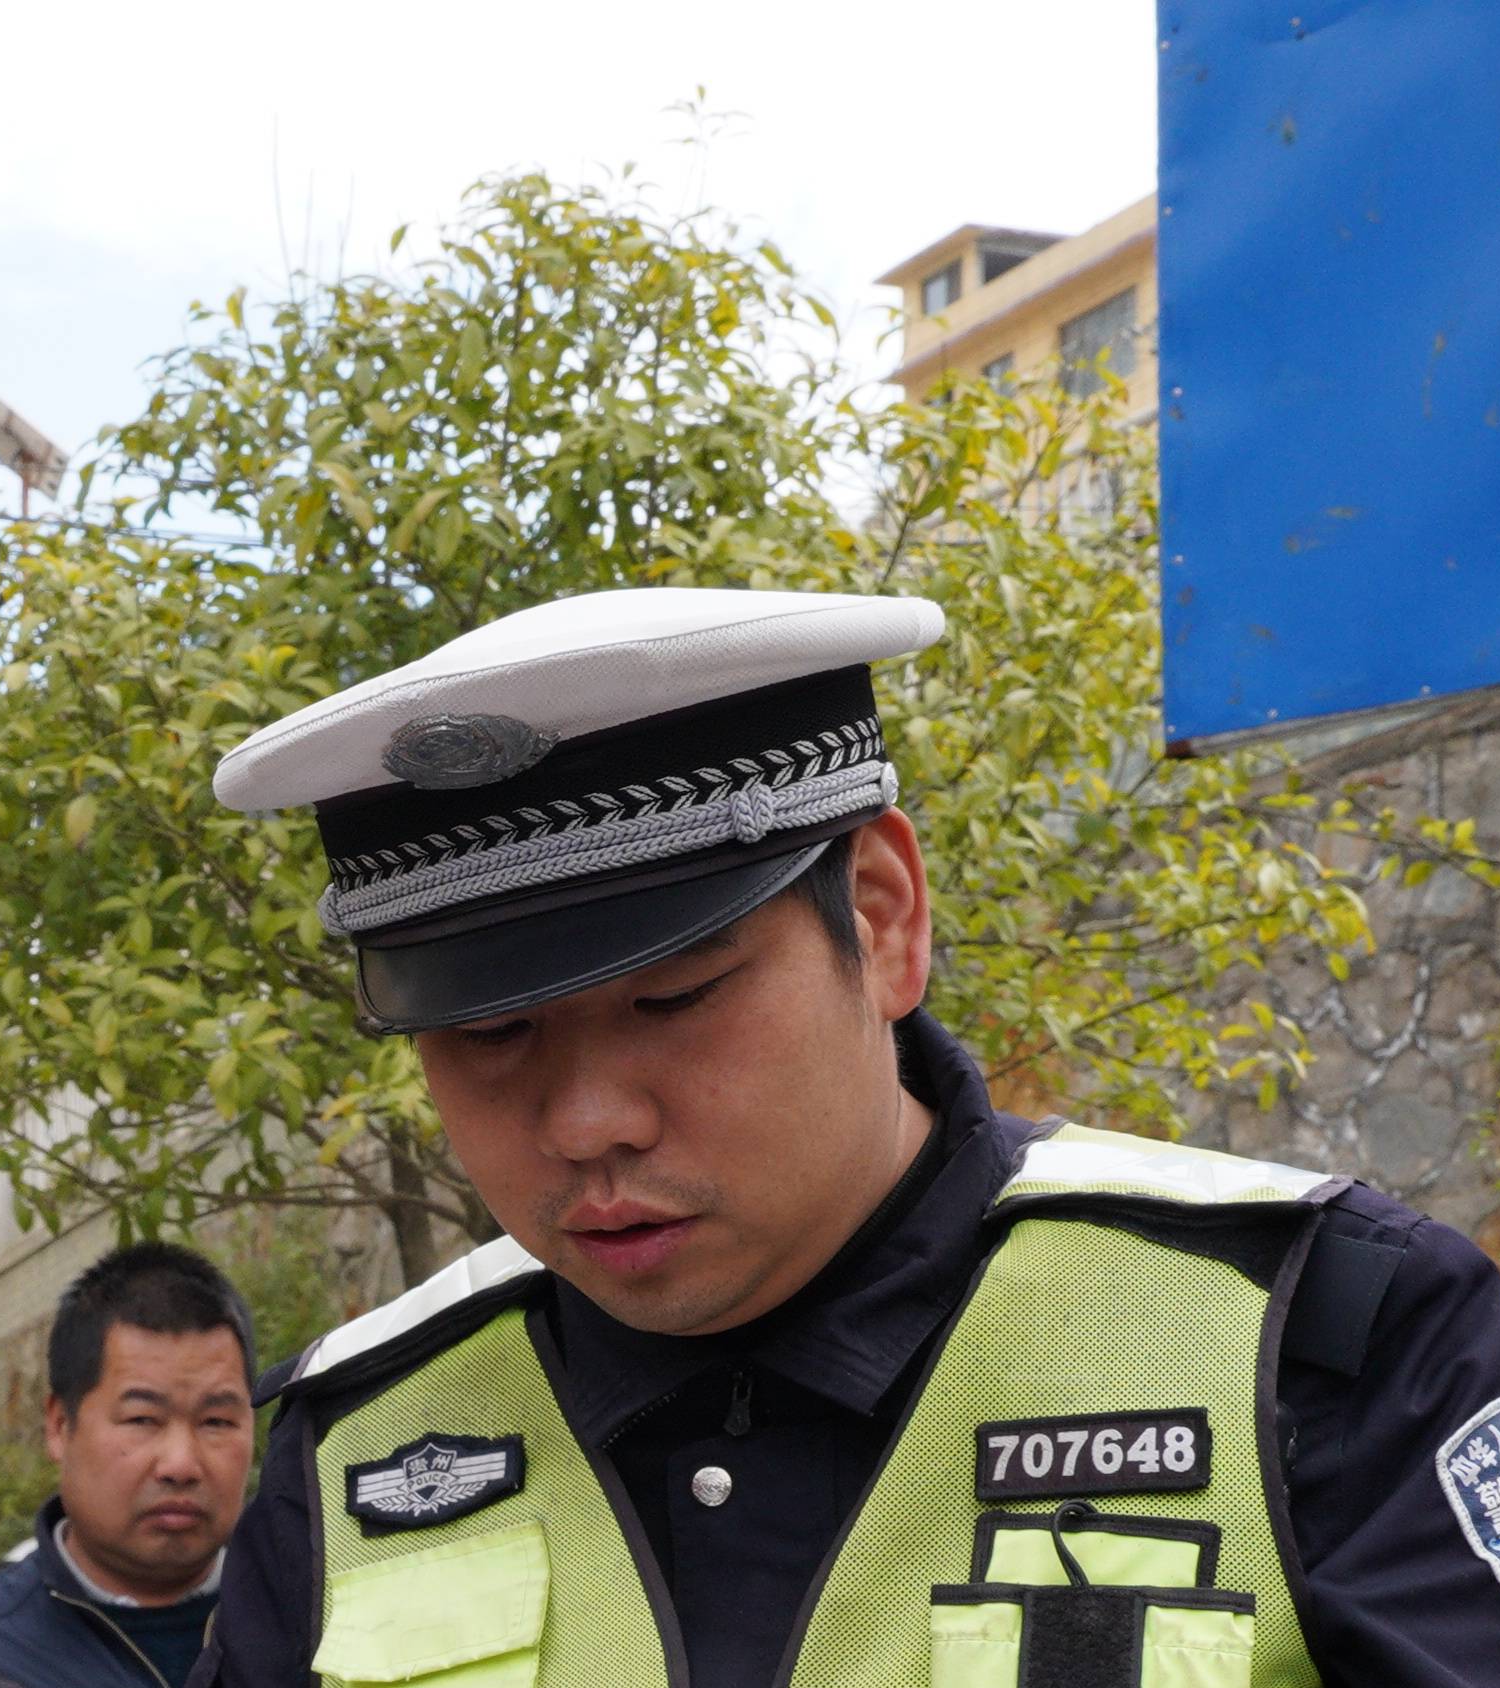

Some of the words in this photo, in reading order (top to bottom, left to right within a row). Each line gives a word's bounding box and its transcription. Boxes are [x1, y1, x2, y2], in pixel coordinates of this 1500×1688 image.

[407, 1453, 452, 1476] 贵州
[987, 1425, 1196, 1482] 707648
[406, 1473, 449, 1490] POLICE
